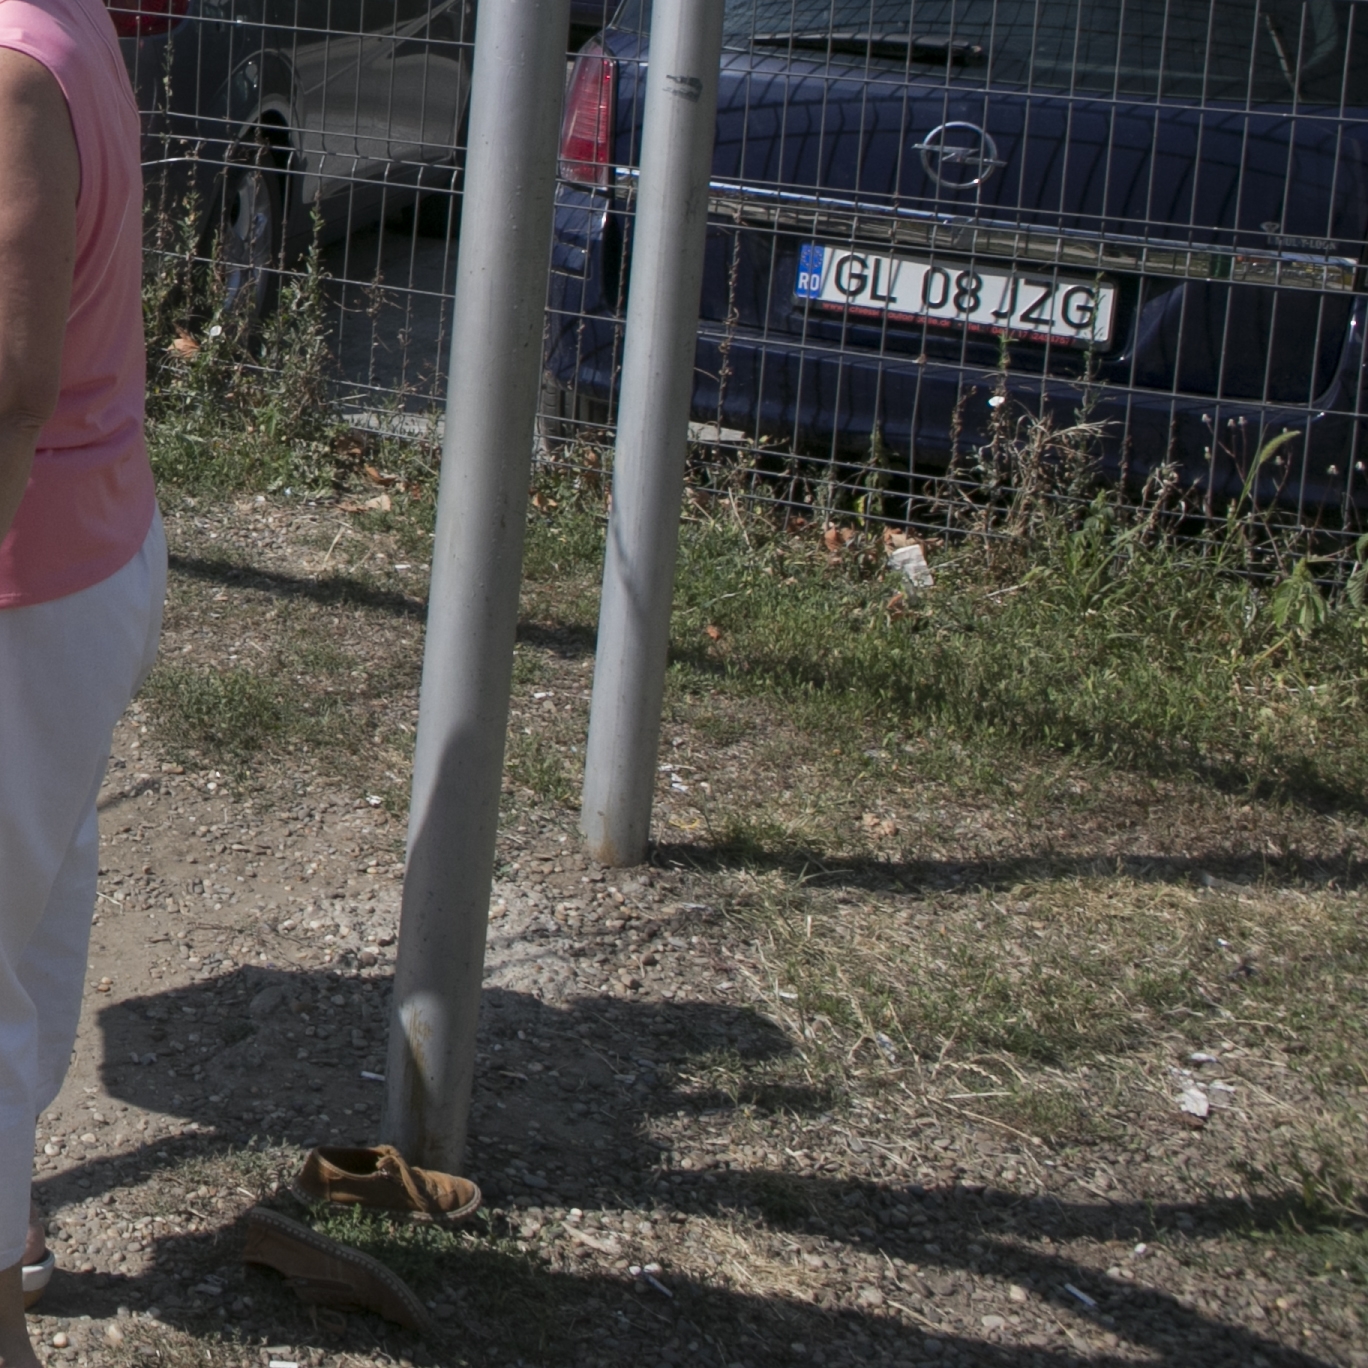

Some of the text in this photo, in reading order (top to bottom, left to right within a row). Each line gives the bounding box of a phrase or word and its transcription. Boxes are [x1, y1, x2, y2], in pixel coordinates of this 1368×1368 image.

[798, 272, 820, 291] RO
[834, 254, 1097, 329] GL 08 JZG
